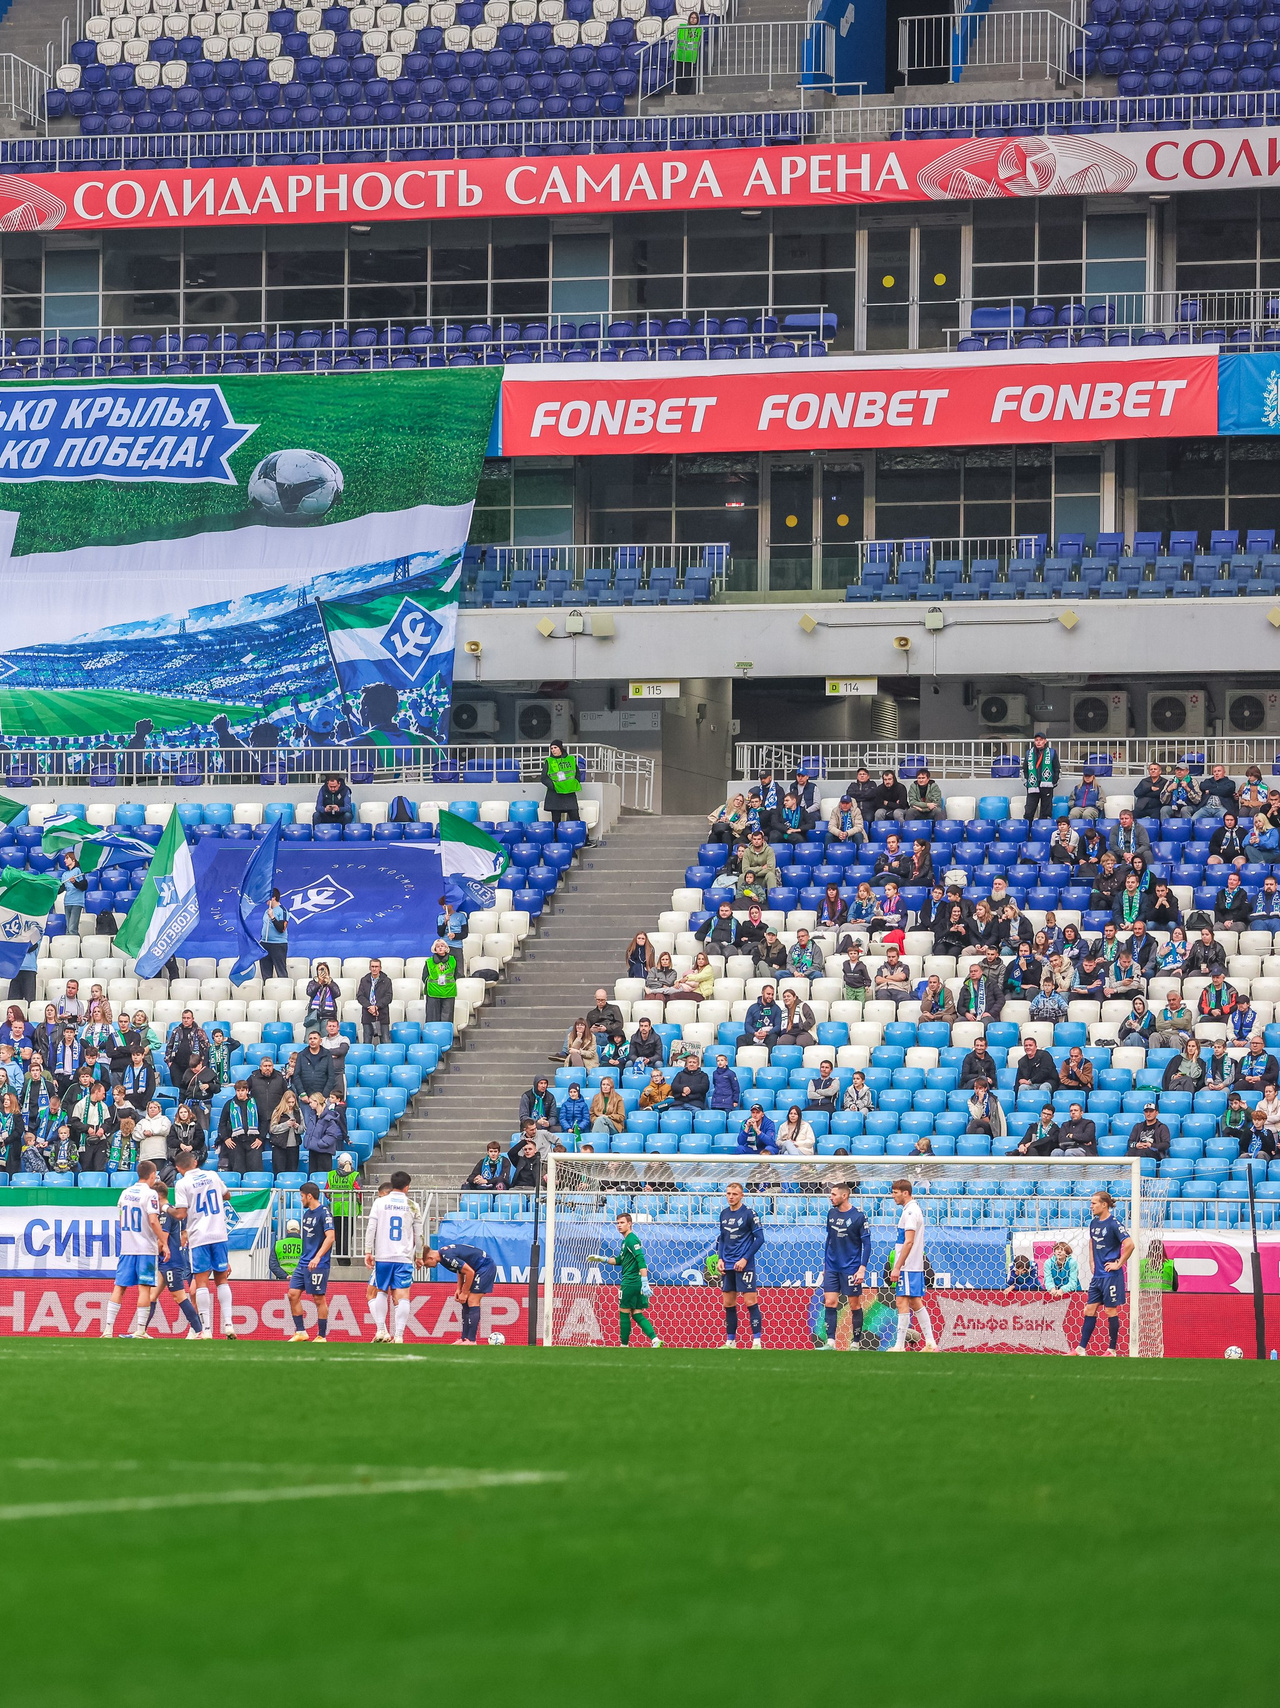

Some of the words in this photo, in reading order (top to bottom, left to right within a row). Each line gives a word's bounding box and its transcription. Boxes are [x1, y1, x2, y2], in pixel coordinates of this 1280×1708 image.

[74, 168, 483, 221] СОЛИДАРНОСТЬ
[505, 158, 723, 205] САМАРА
[743, 151, 910, 197] АРЕНА
[61, 397, 212, 431] КРЫЛЬЯ,
[530, 396, 717, 437] FONBET
[757, 388, 949, 431] FONBET
[990, 379, 1188, 424] FONBET
[54, 434, 215, 471] ПОБЕДА!
[646, 686, 662, 695] 115
[844, 682, 859, 692] 114
[196, 1188, 220, 1217] 40
[122, 1205, 142, 1232] 10
[390, 1216, 402, 1242] 8
[282, 1244, 301, 1254] 9875
[166, 1270, 174, 1282] 8
[311, 1274, 323, 1285] 97
[474, 1274, 480, 1284] 4
[742, 1272, 754, 1283] 47
[1109, 1285, 1116, 1297] 2
[953, 1314, 1008, 1334] Альфа
[1012, 1315, 1056, 1332] Банк
